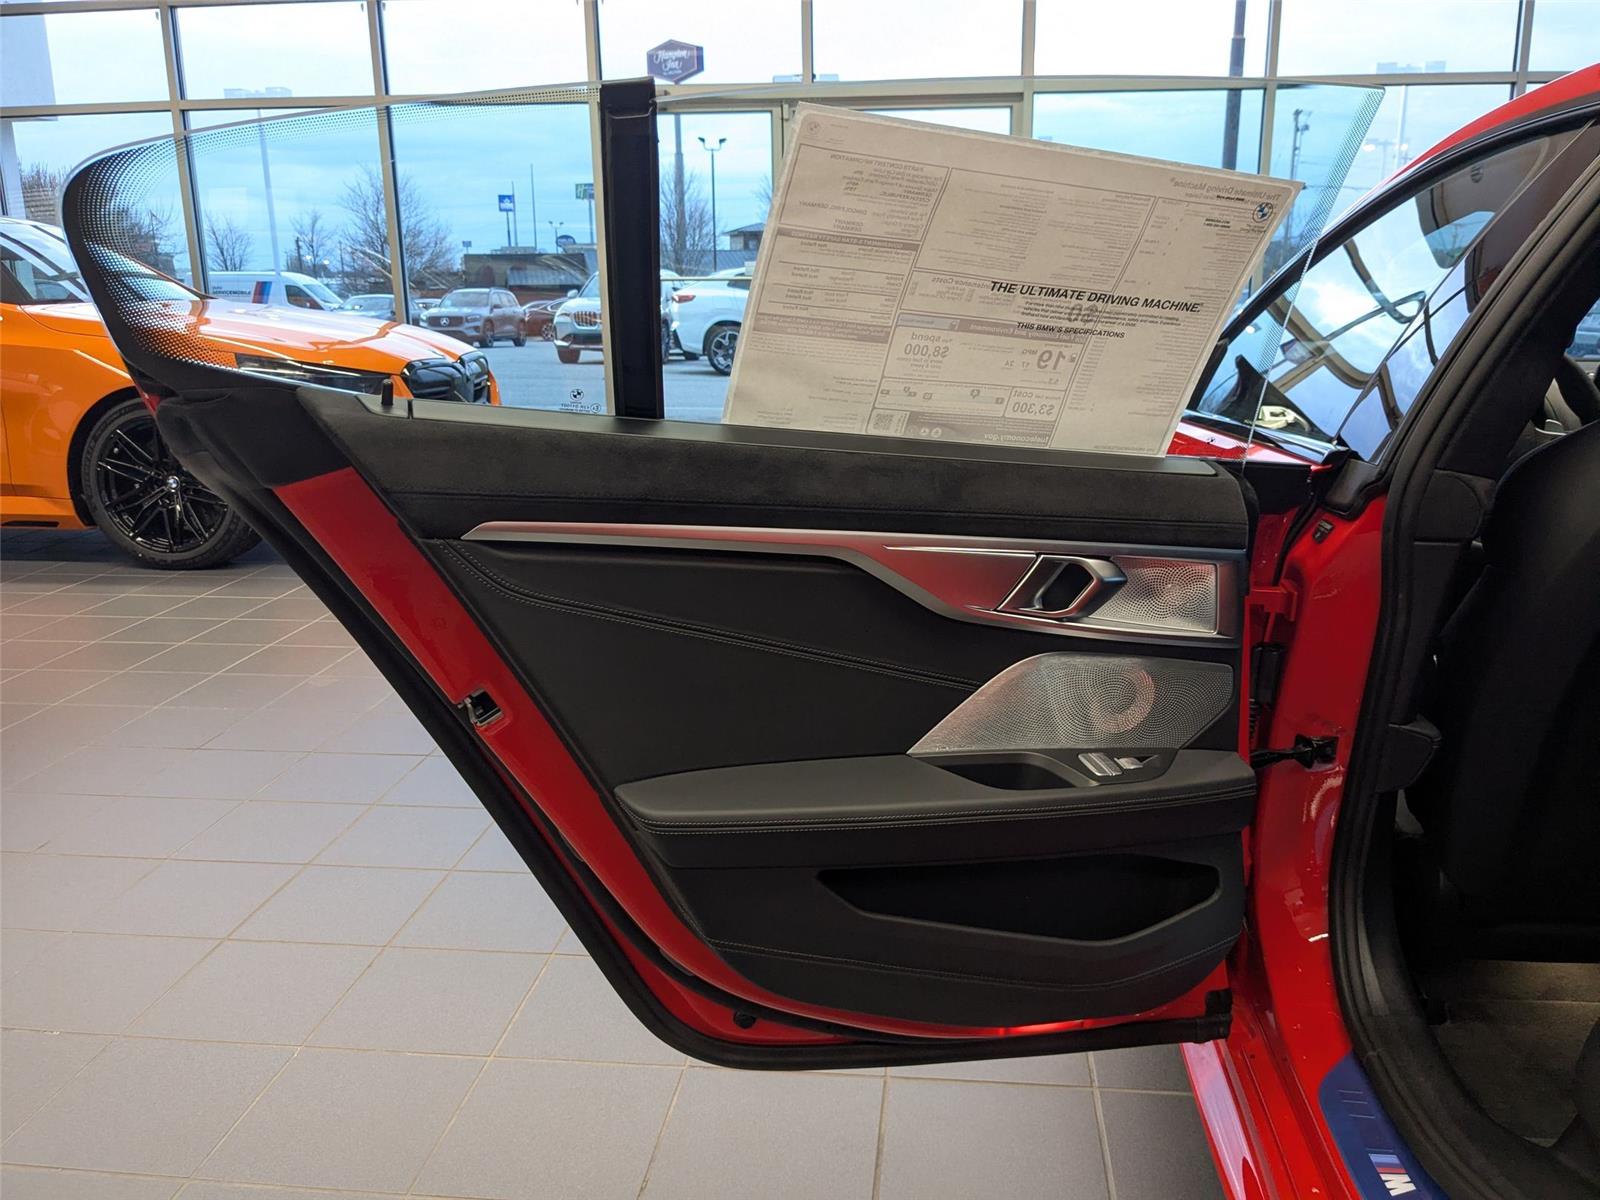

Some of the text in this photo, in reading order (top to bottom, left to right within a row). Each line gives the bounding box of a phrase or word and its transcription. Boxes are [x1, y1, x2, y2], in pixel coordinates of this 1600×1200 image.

[990, 280, 1018, 294] THE
[1020, 284, 1086, 301] ULTIMATE
[1087, 292, 1140, 307] DRIVING
[1017, 322, 1034, 330] THIS
[1064, 326, 1126, 339] SPECIFICATIONS
[1379, 1173, 1417, 1197] M
